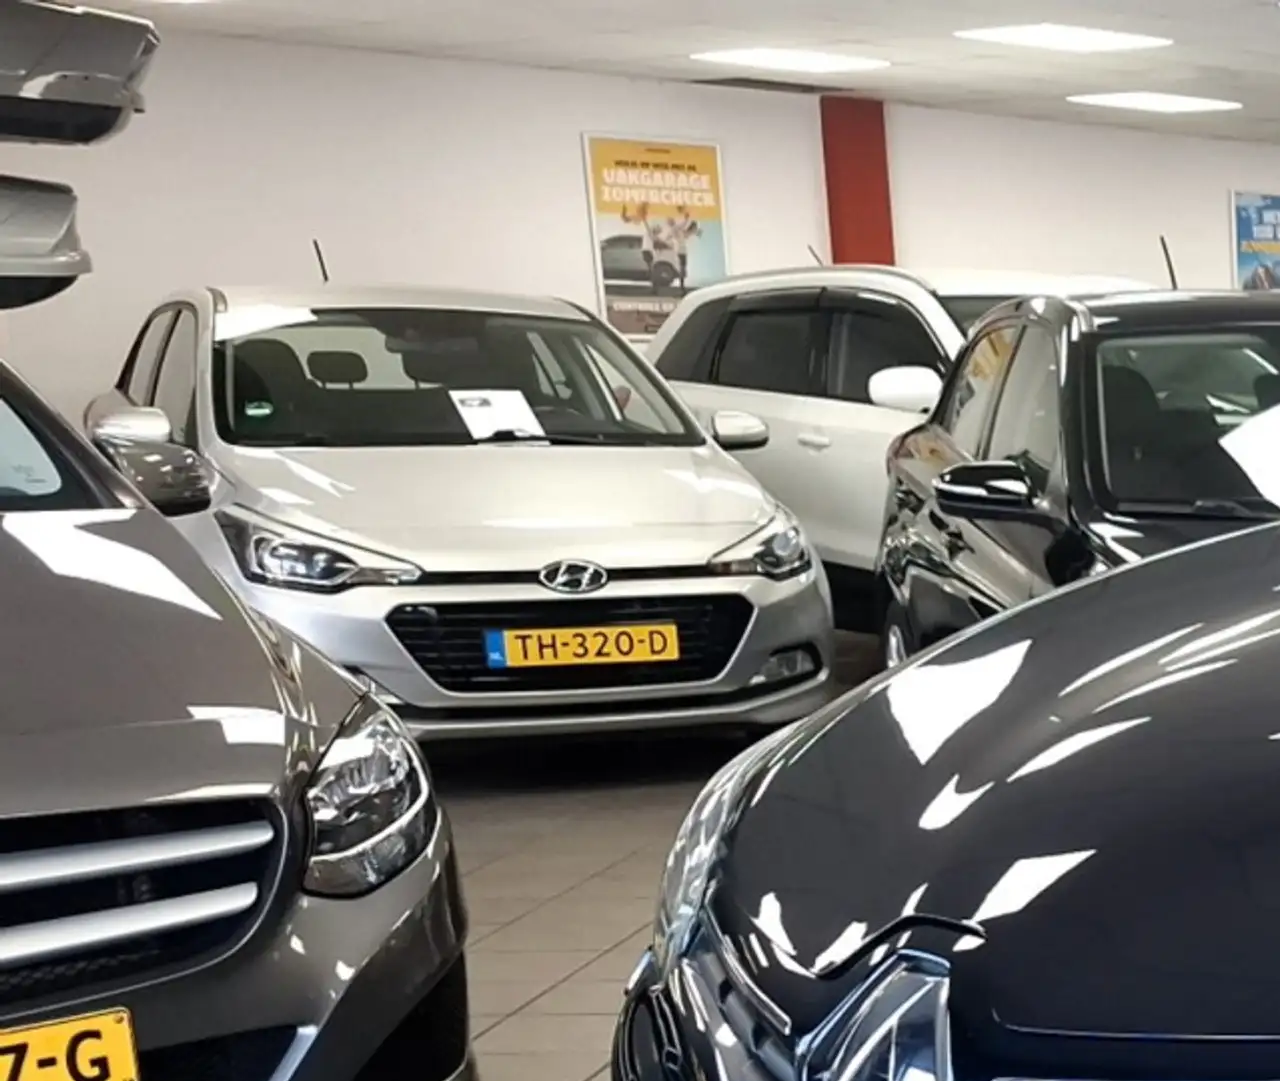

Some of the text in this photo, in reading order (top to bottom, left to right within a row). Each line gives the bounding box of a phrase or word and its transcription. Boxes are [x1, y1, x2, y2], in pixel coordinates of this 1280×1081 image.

[602, 167, 711, 190] VAKGARAGE
[601, 185, 716, 206] ZOMERCHECK
[514, 629, 668, 661] TH-320-D
